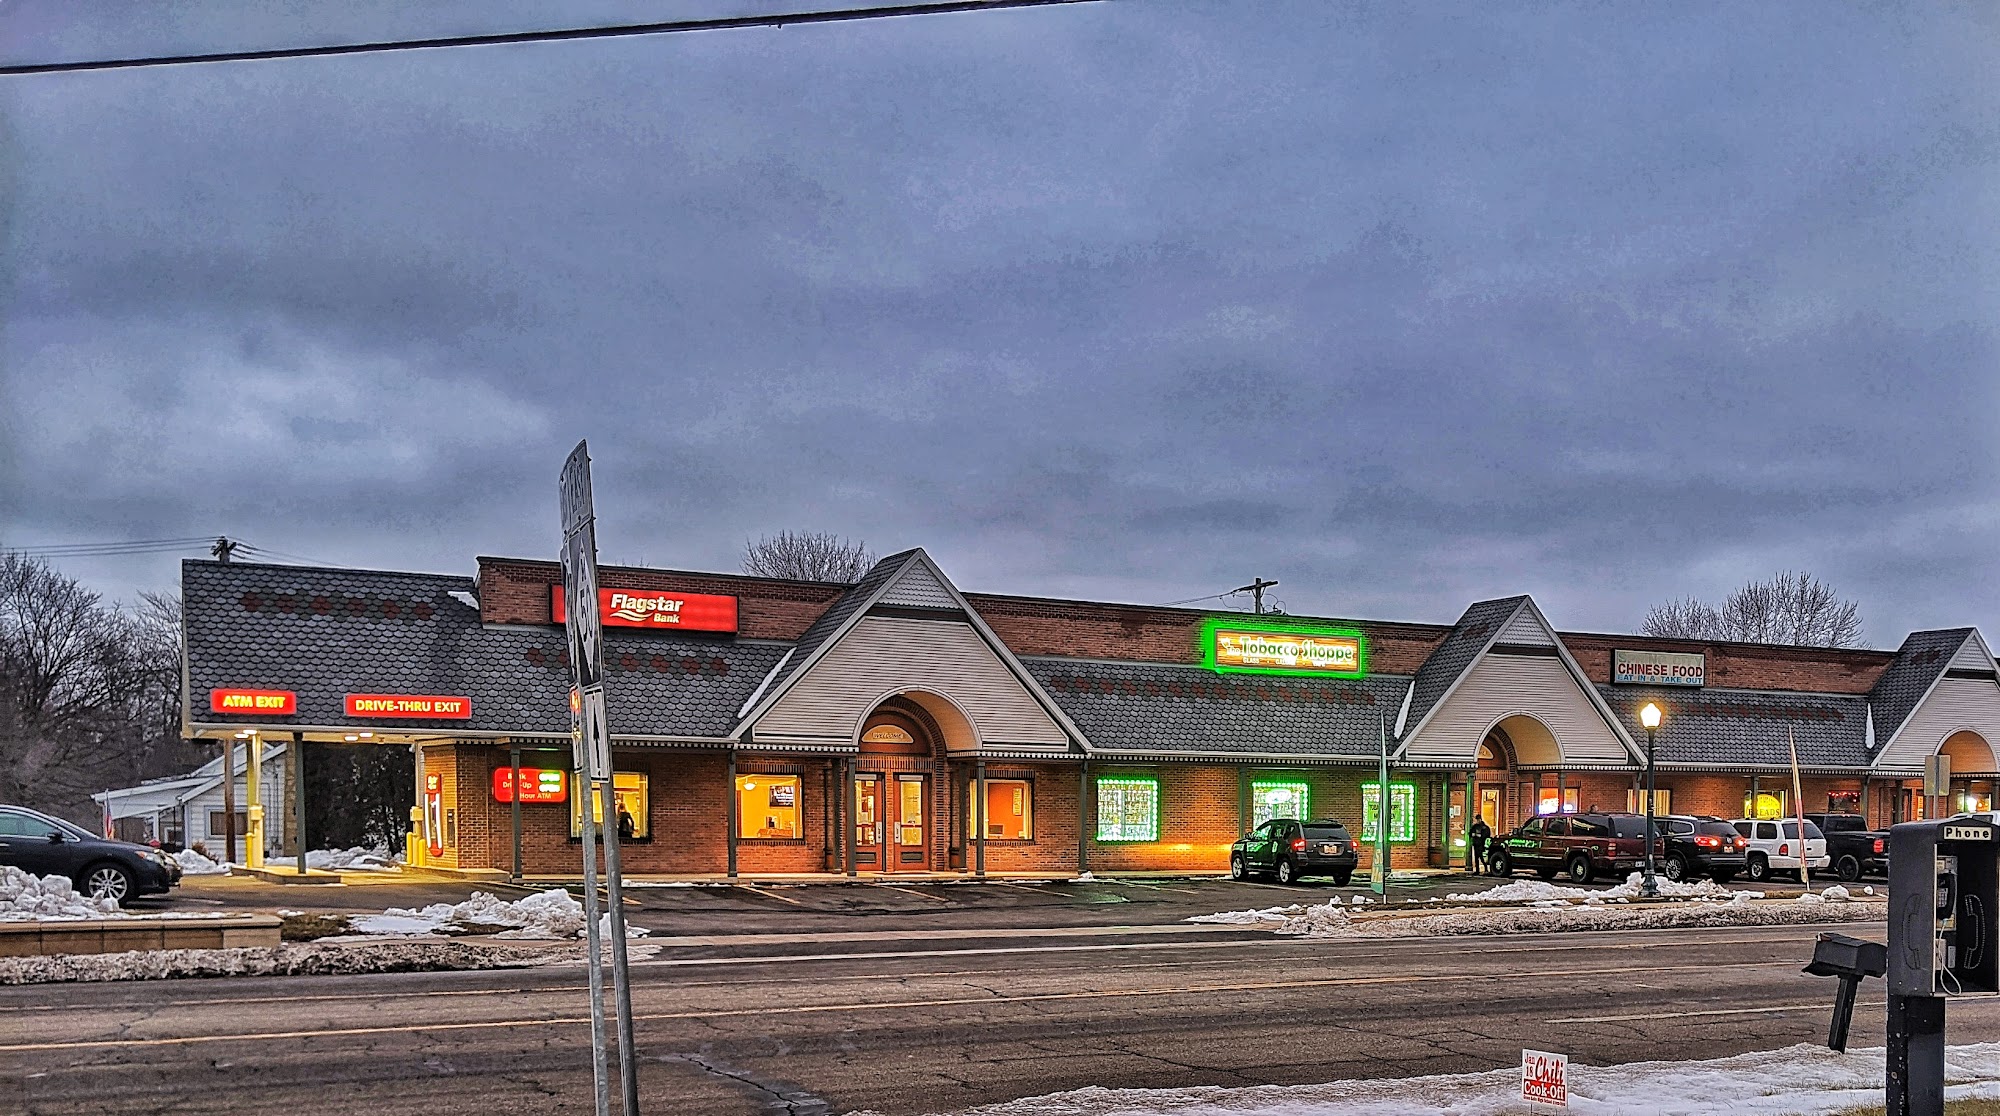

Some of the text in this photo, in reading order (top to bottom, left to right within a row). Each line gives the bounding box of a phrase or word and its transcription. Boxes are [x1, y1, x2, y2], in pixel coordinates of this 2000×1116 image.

[610, 593, 684, 613] Flagstar
[579, 584, 593, 642] 50
[653, 612, 680, 624] Bank
[1242, 637, 1298, 656] Tobacco
[1302, 640, 1352, 661] Shoppe
[1618, 663, 1703, 677] CHINESE FOOD
[222, 695, 286, 708] ATM EXIT
[355, 699, 462, 713] DRIVE-THRU EXIT
[507, 772, 526, 780] Bnk
[502, 781, 532, 789] Dri-Up
[1946, 827, 1989, 838] Phone
[1525, 1052, 1535, 1064] Jan
[1535, 1056, 1564, 1085] Chili
[1524, 1081, 1565, 1100] Cook-Off
